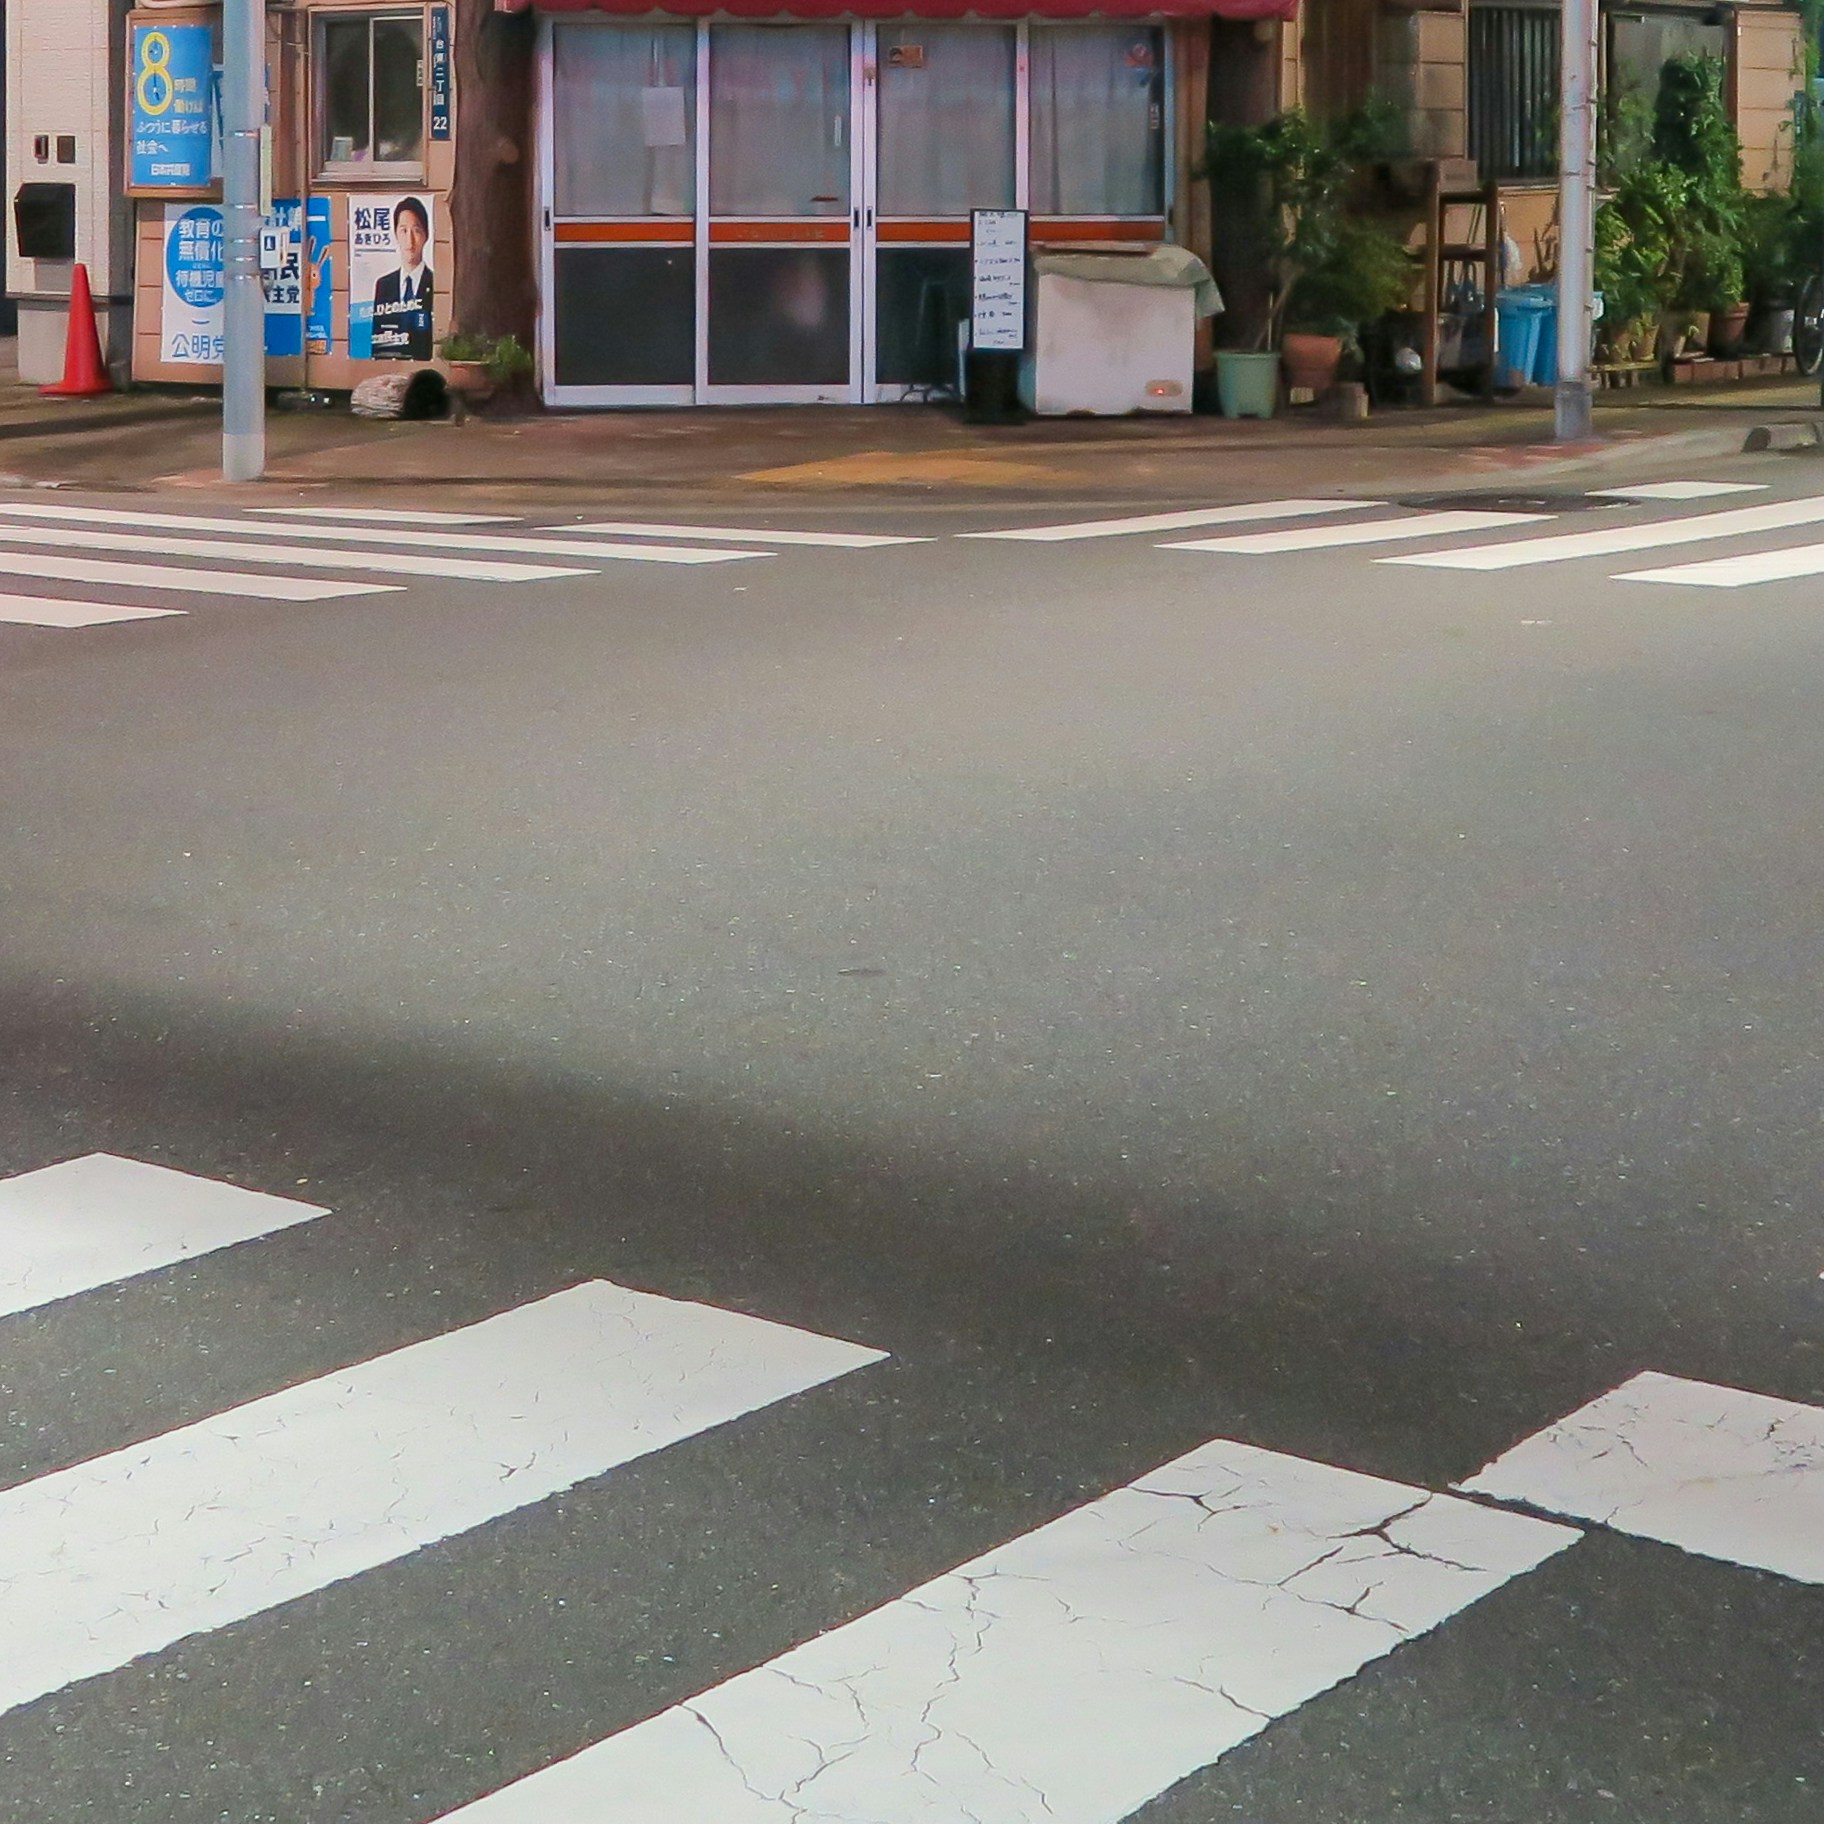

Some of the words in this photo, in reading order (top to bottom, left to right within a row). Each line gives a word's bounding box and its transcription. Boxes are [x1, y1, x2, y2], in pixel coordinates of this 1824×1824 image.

[137, 32, 173, 115] 8
[433, 116, 447, 130] 22
[354, 207, 390, 231] 松尾
[171, 333, 224, 360] 公明党
